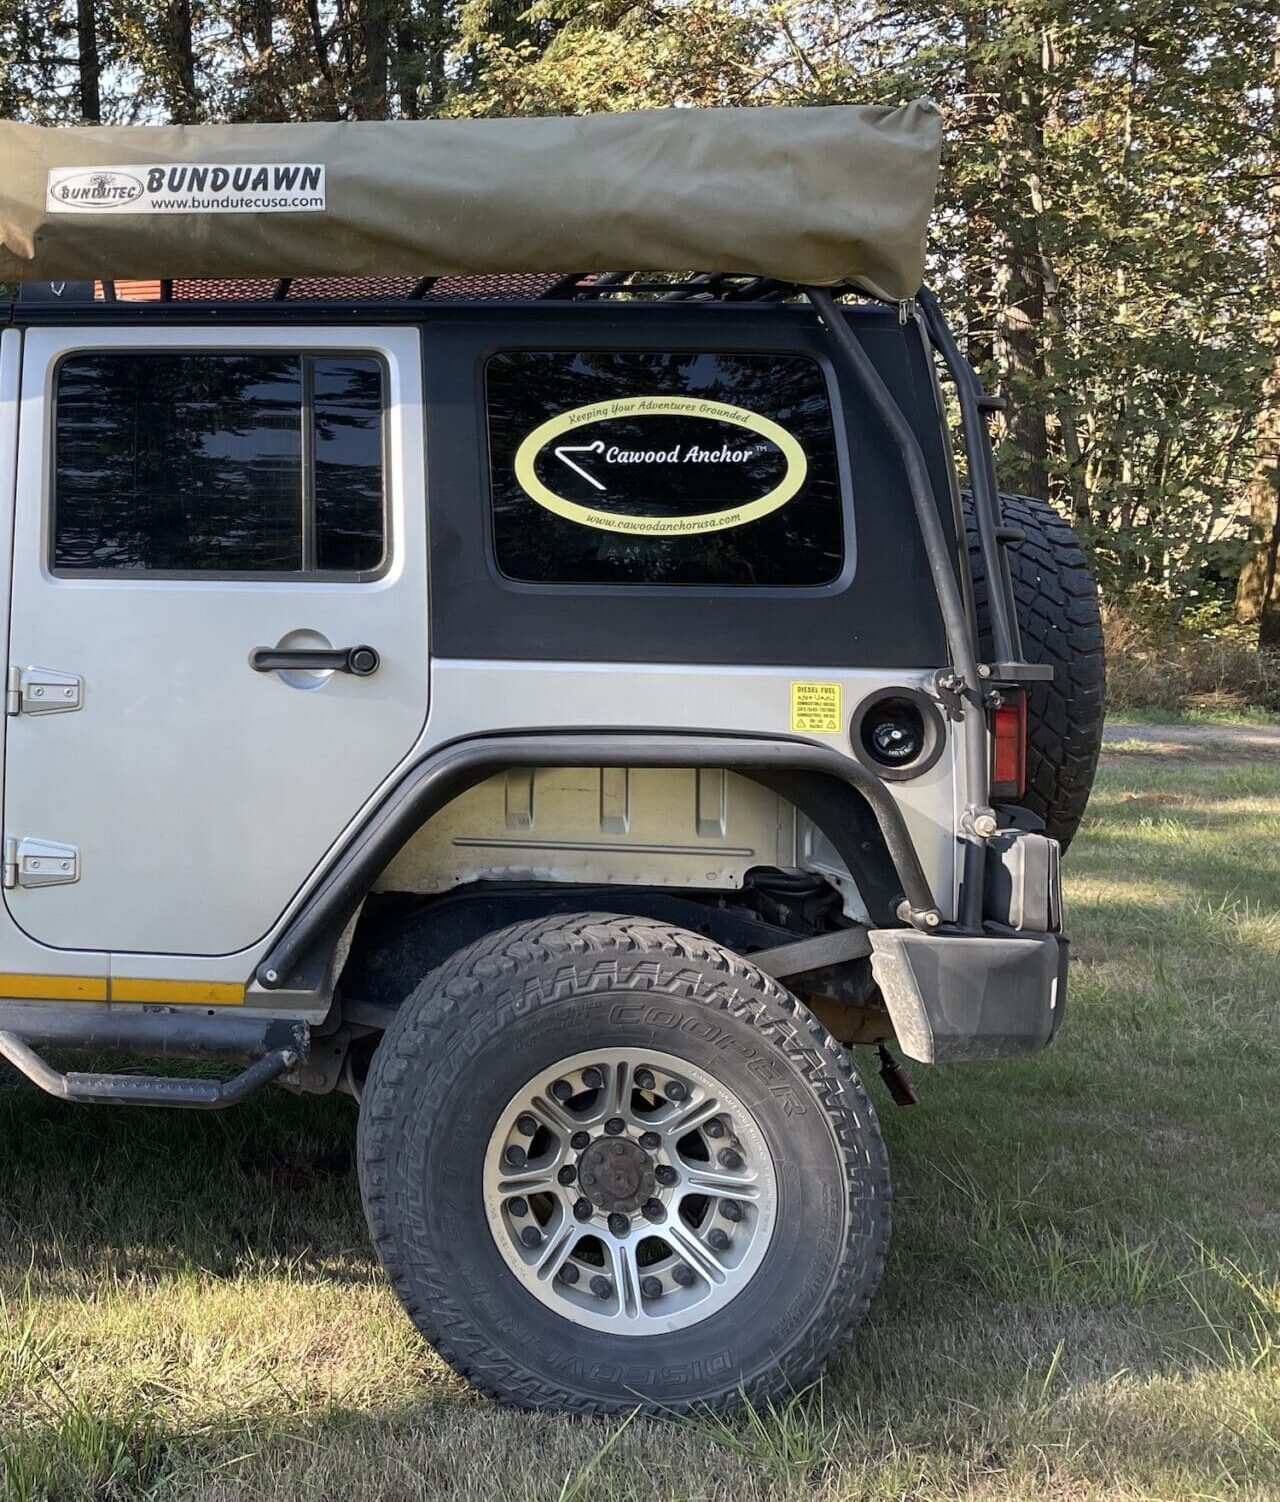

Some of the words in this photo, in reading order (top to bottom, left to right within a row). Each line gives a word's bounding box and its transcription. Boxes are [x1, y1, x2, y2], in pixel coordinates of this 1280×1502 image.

[146, 166, 322, 193] BUNDUAWN
[60, 184, 136, 199] BUNDUTEC
[150, 196, 324, 210] www.bundutecusa.com
[568, 406, 609, 425] Keeping
[611, 401, 637, 418] Your
[638, 400, 697, 413] Adventures
[698, 403, 752, 425] Grounded
[605, 444, 680, 464] Cawood
[585, 512, 742, 532] www.cawoodanchorusa.com
[608, 1003, 808, 1118] COOPER
